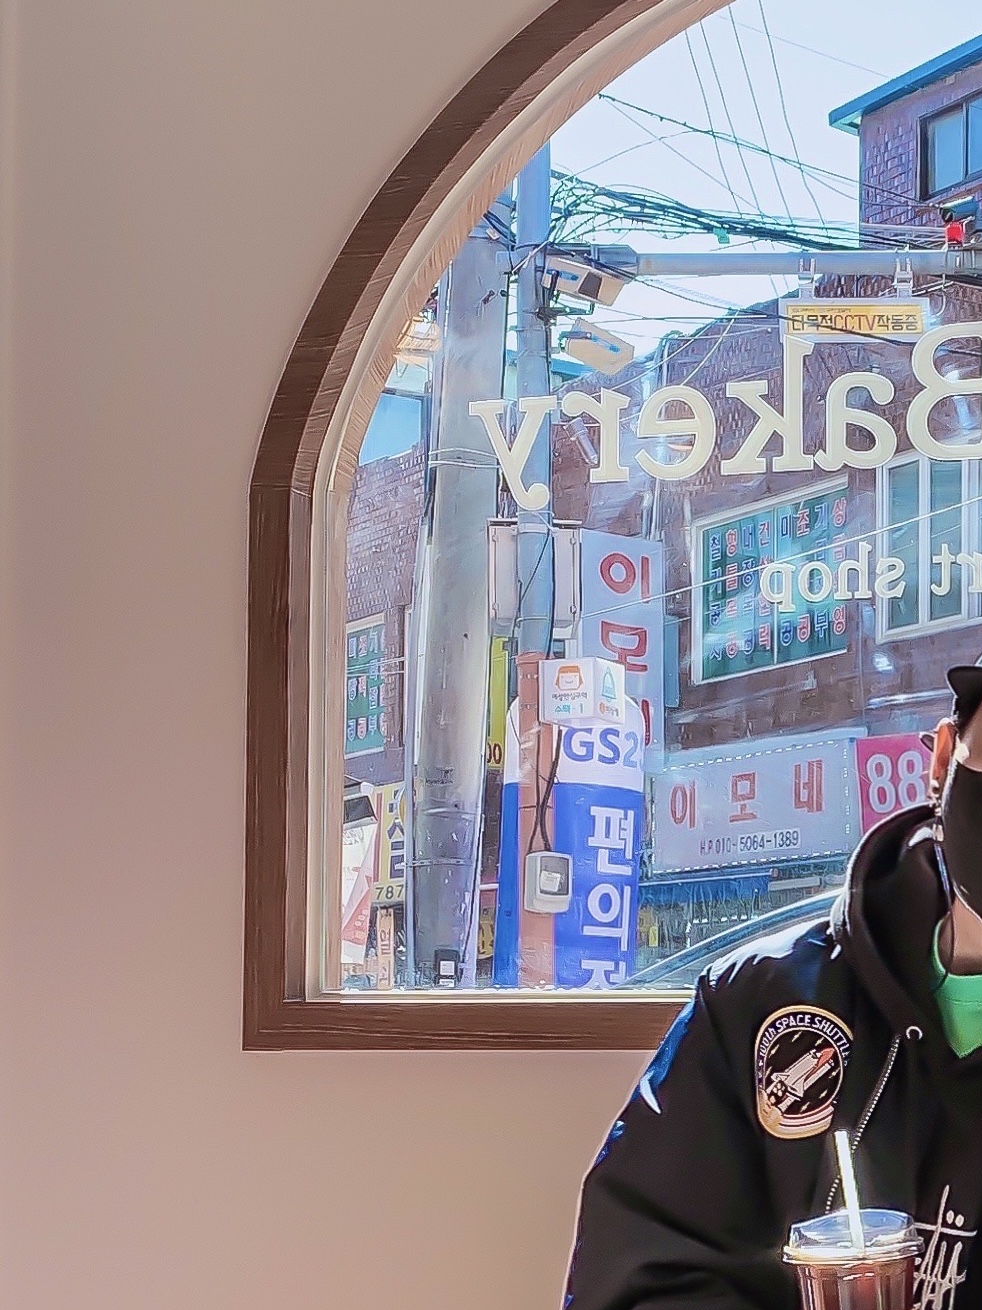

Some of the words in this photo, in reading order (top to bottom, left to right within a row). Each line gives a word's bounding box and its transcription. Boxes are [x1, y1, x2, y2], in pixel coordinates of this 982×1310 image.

[599, 552, 651, 747] 이모
[563, 727, 646, 768] GS2
[669, 758, 825, 829] 이모네
[776, 1014, 811, 1033] SPACE
